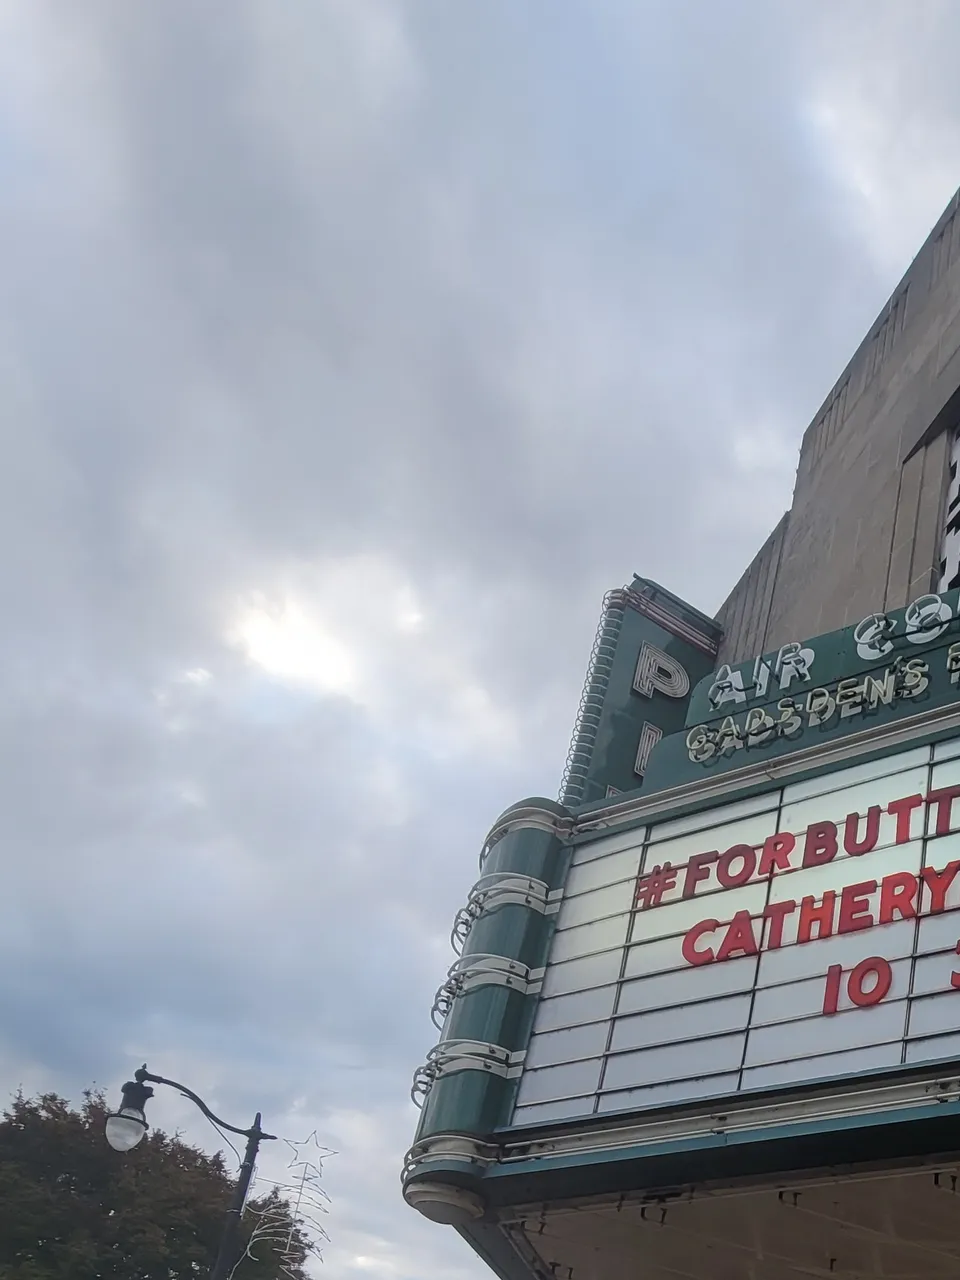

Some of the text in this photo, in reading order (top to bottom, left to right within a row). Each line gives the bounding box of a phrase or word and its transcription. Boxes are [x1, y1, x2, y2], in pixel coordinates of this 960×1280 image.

[686, 656, 930, 763] GADSDEN'S
[708, 642, 815, 712] AIR
[821, 955, 893, 1016] 10
